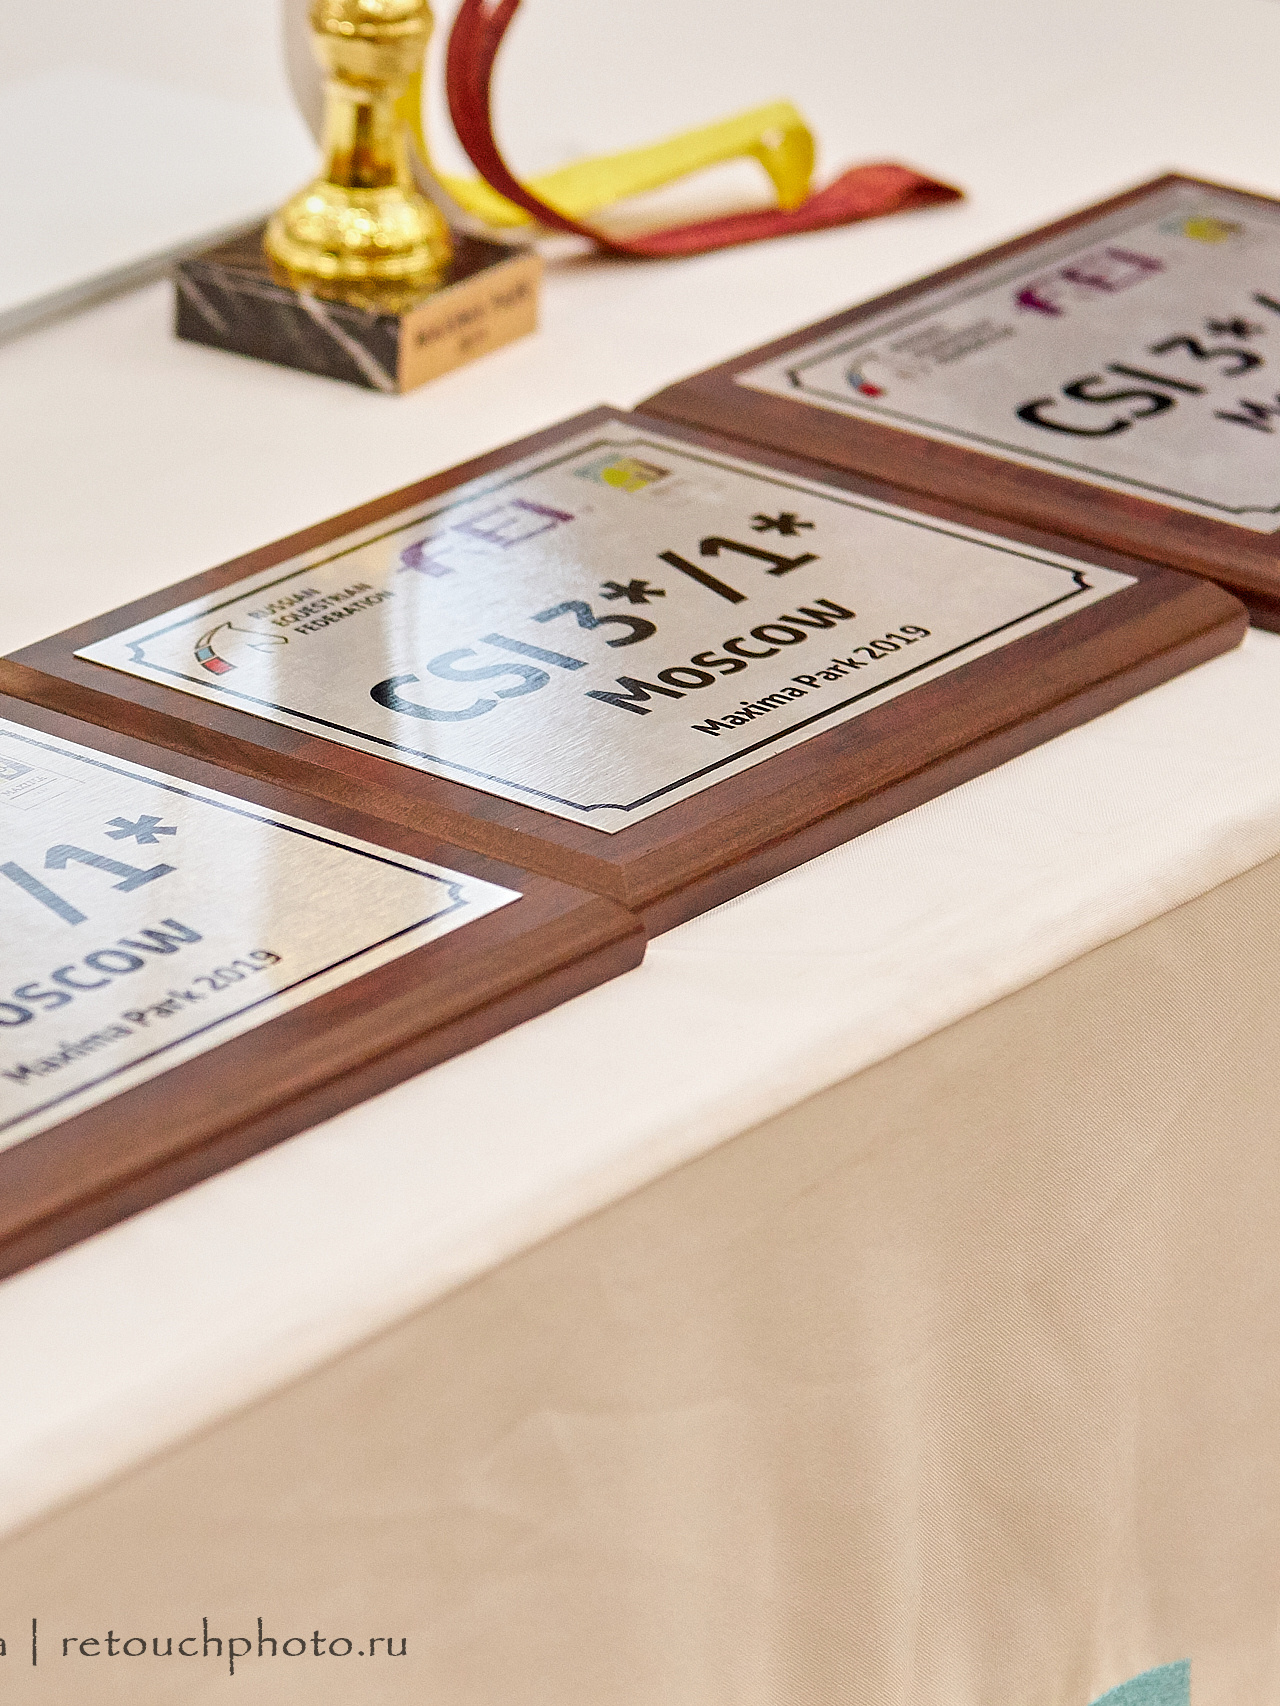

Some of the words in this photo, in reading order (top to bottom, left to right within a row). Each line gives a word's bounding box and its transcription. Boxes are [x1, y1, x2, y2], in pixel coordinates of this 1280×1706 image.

[1016, 362, 1206, 436] CSI
[272, 583, 373, 627] EQUESTRIAN
[294, 591, 395, 635] FEDERATION
[370, 632, 588, 722] CSI
[691, 685, 808, 737] Maxima
[791, 657, 869, 689] Park
[853, 624, 932, 660] 2019
[0, 1023, 133, 1086] Maxima
[122, 988, 204, 1028] Park
[192, 948, 282, 991] 2019
